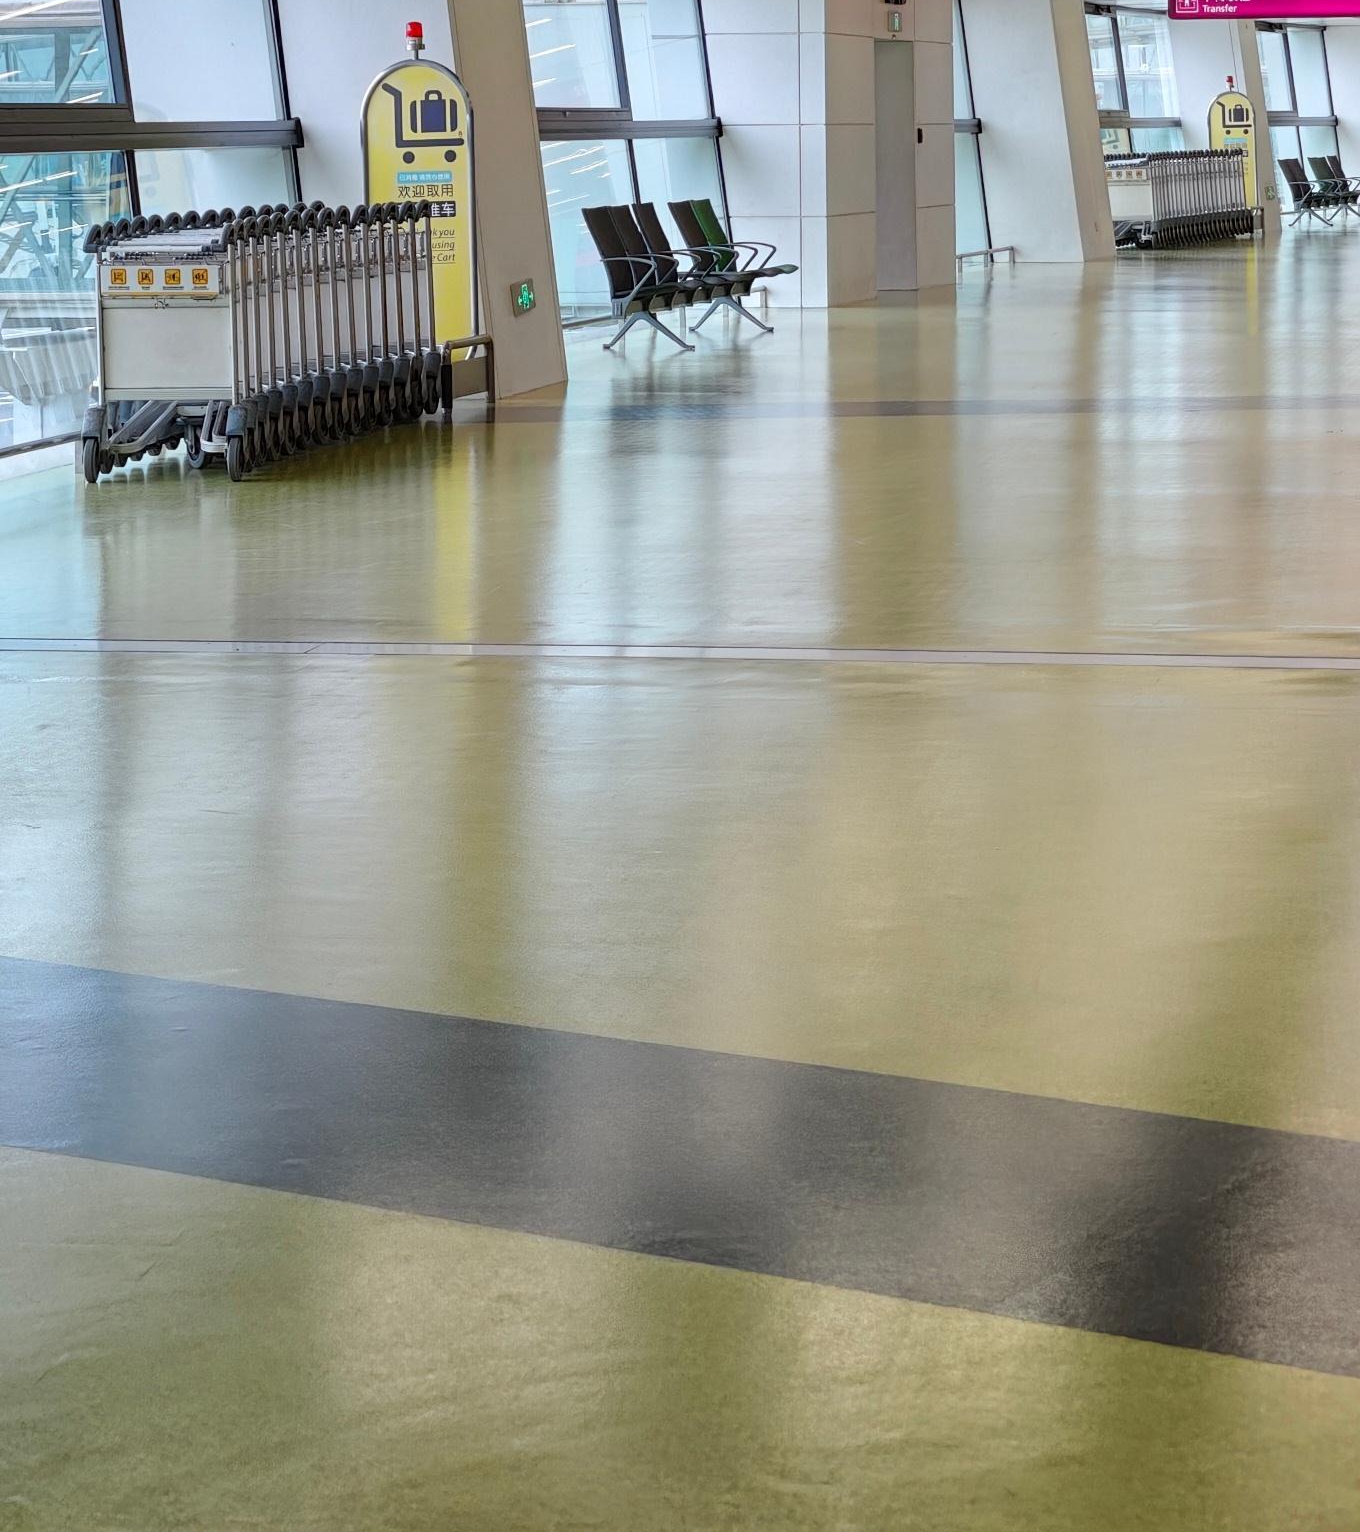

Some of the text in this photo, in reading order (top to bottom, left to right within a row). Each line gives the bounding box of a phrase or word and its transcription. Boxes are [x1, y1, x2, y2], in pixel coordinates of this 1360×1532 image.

[1202, 3, 1237, 13] Transfer
[398, 184, 454, 198] 欢迎取用
[439, 229, 455, 238] you
[431, 241, 455, 251] using
[437, 253, 456, 262] Cart
